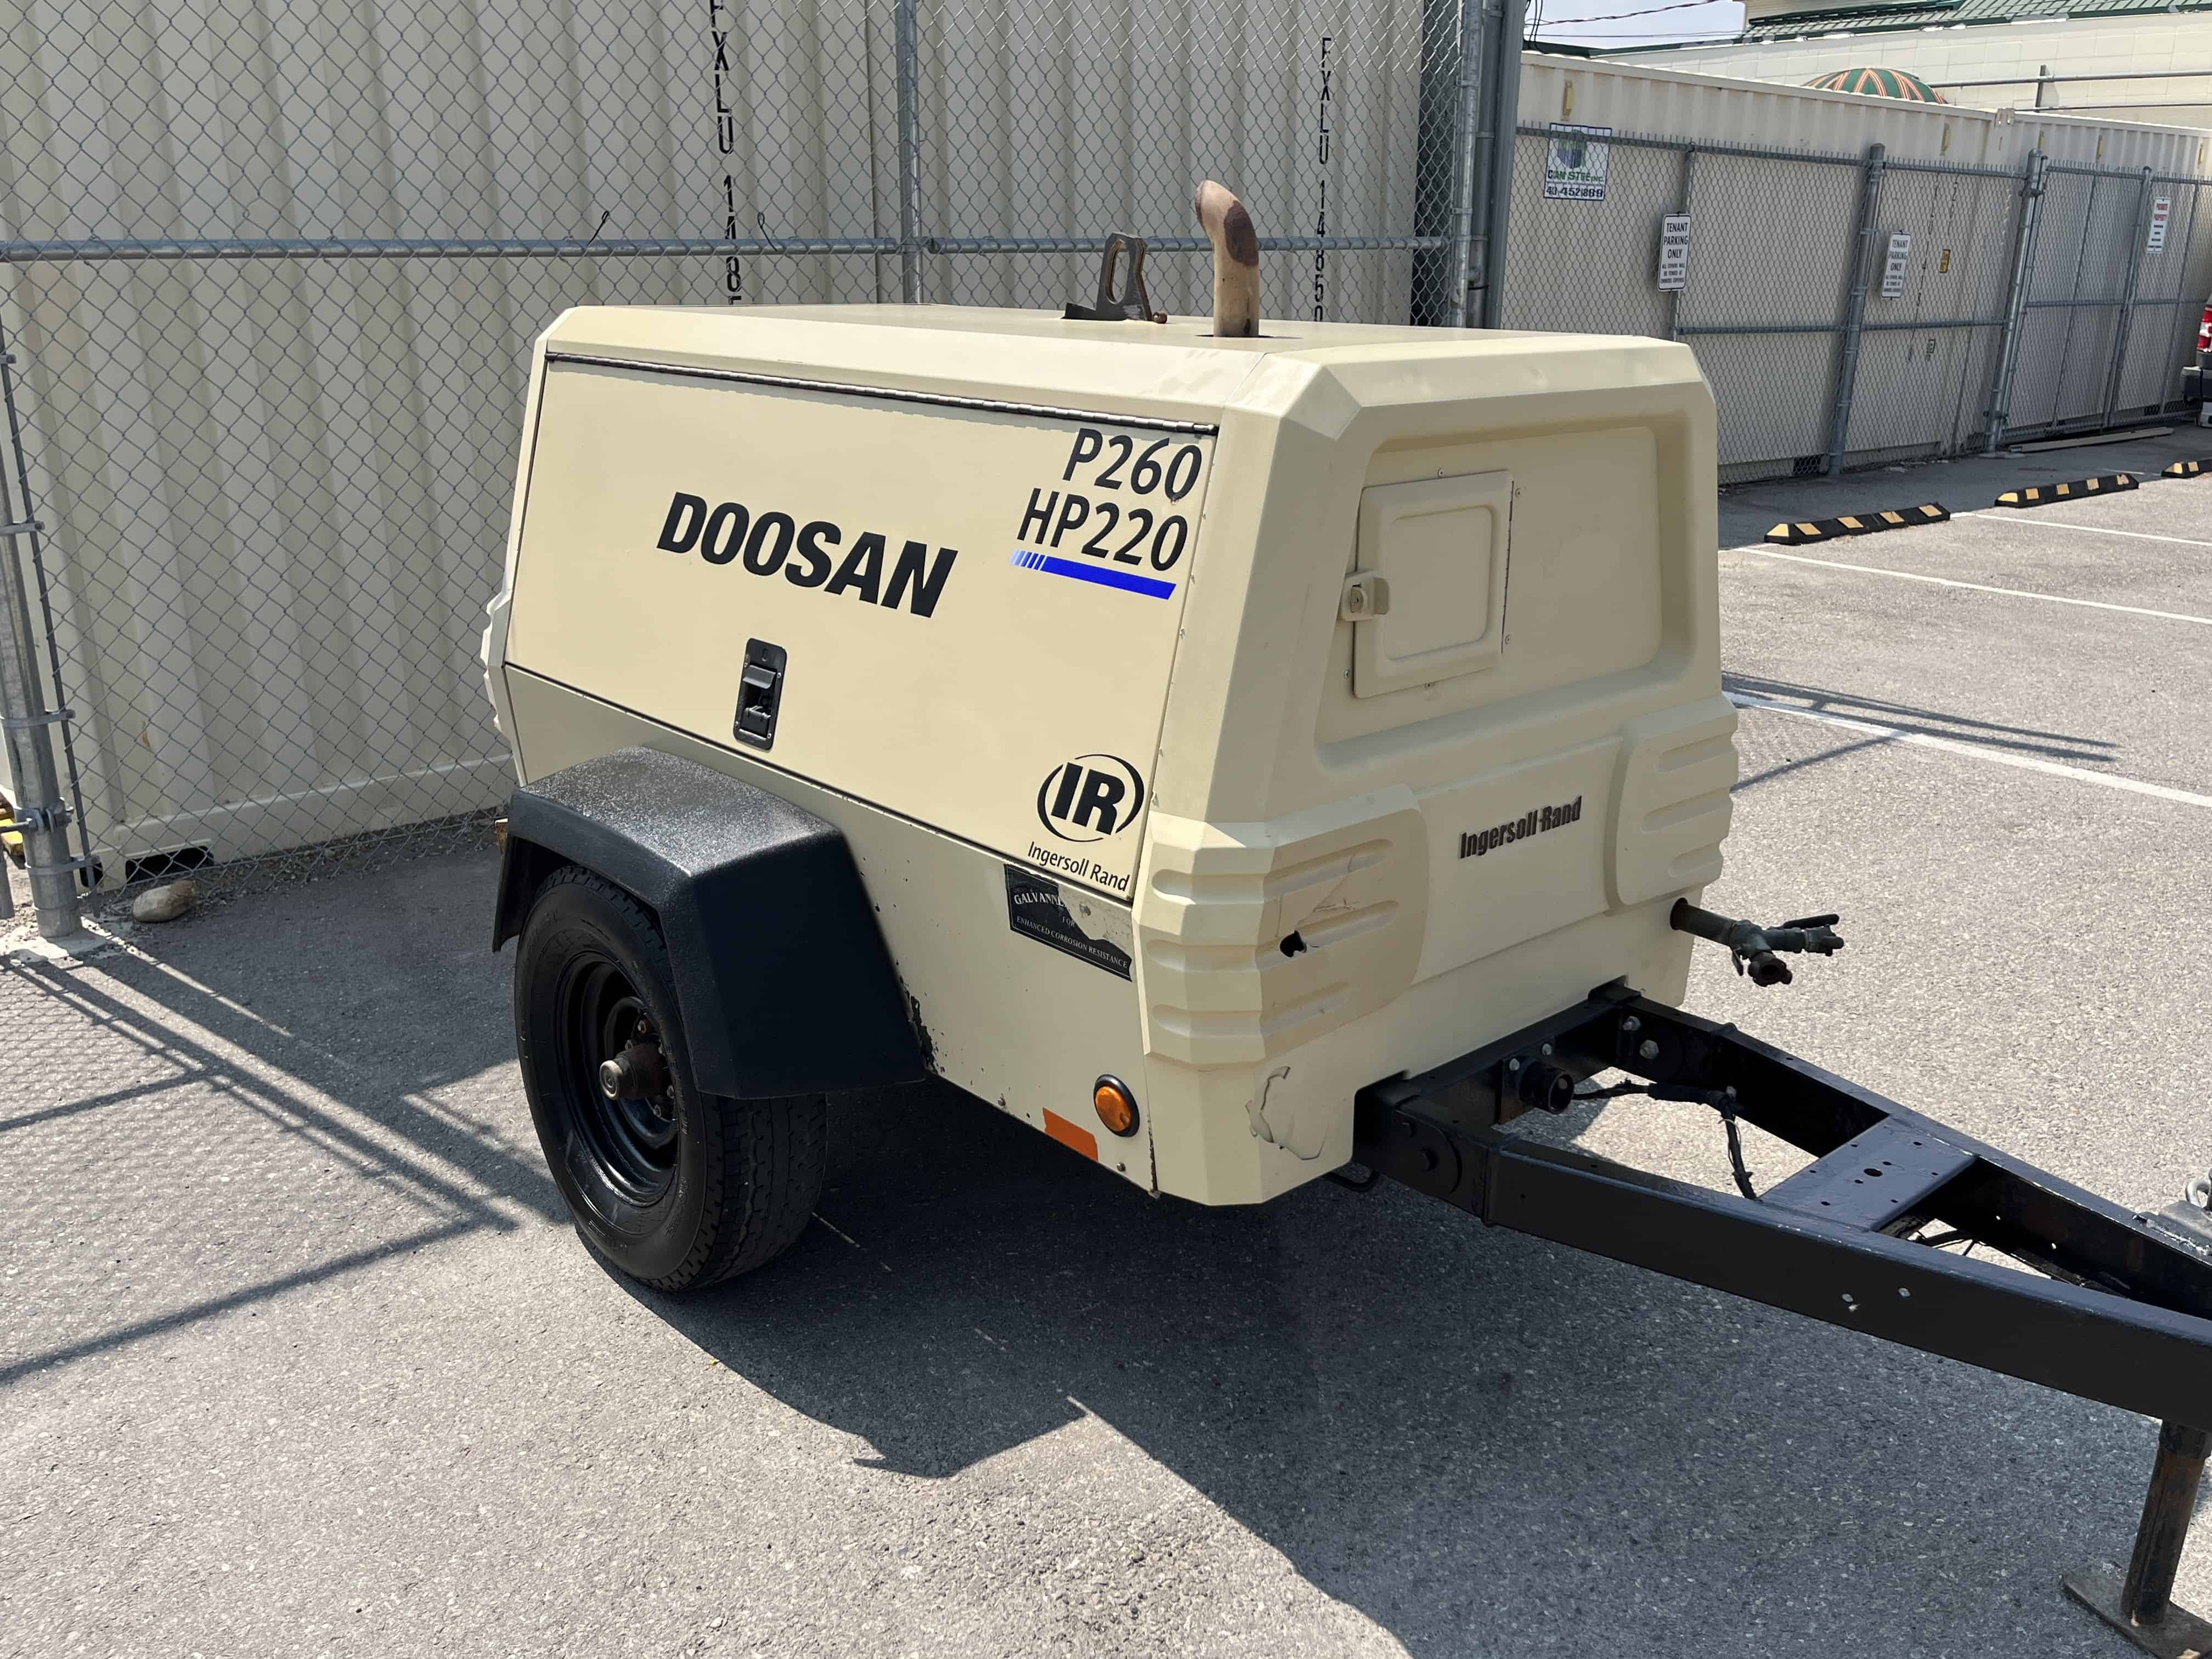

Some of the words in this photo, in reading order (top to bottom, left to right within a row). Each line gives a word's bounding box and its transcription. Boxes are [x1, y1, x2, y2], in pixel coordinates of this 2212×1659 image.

[1319, 37, 1332, 165] FXLU
[723, 175, 742, 305] 148
[1663, 236, 1689, 245] PARKING
[1667, 223, 1688, 233] TENANT
[1668, 249, 1683, 258] ONLY
[1892, 240, 1908, 249] TENANT
[1891, 263, 1903, 271] ONLY
[1063, 428, 1203, 501] P260
[657, 492, 958, 618] DOOSAN
[1017, 487, 1188, 572] HP220
[1051, 762, 1126, 836] IR
[1028, 841, 1090, 877] Ingersoll
[1090, 864, 1130, 891] Rand
[1017, 916, 1051, 935] ENHANCED
[1051, 929, 1087, 952] CORROSION
[1088, 945, 1128, 968] RESISTANCE
[1062, 916, 1075, 927] FOR
